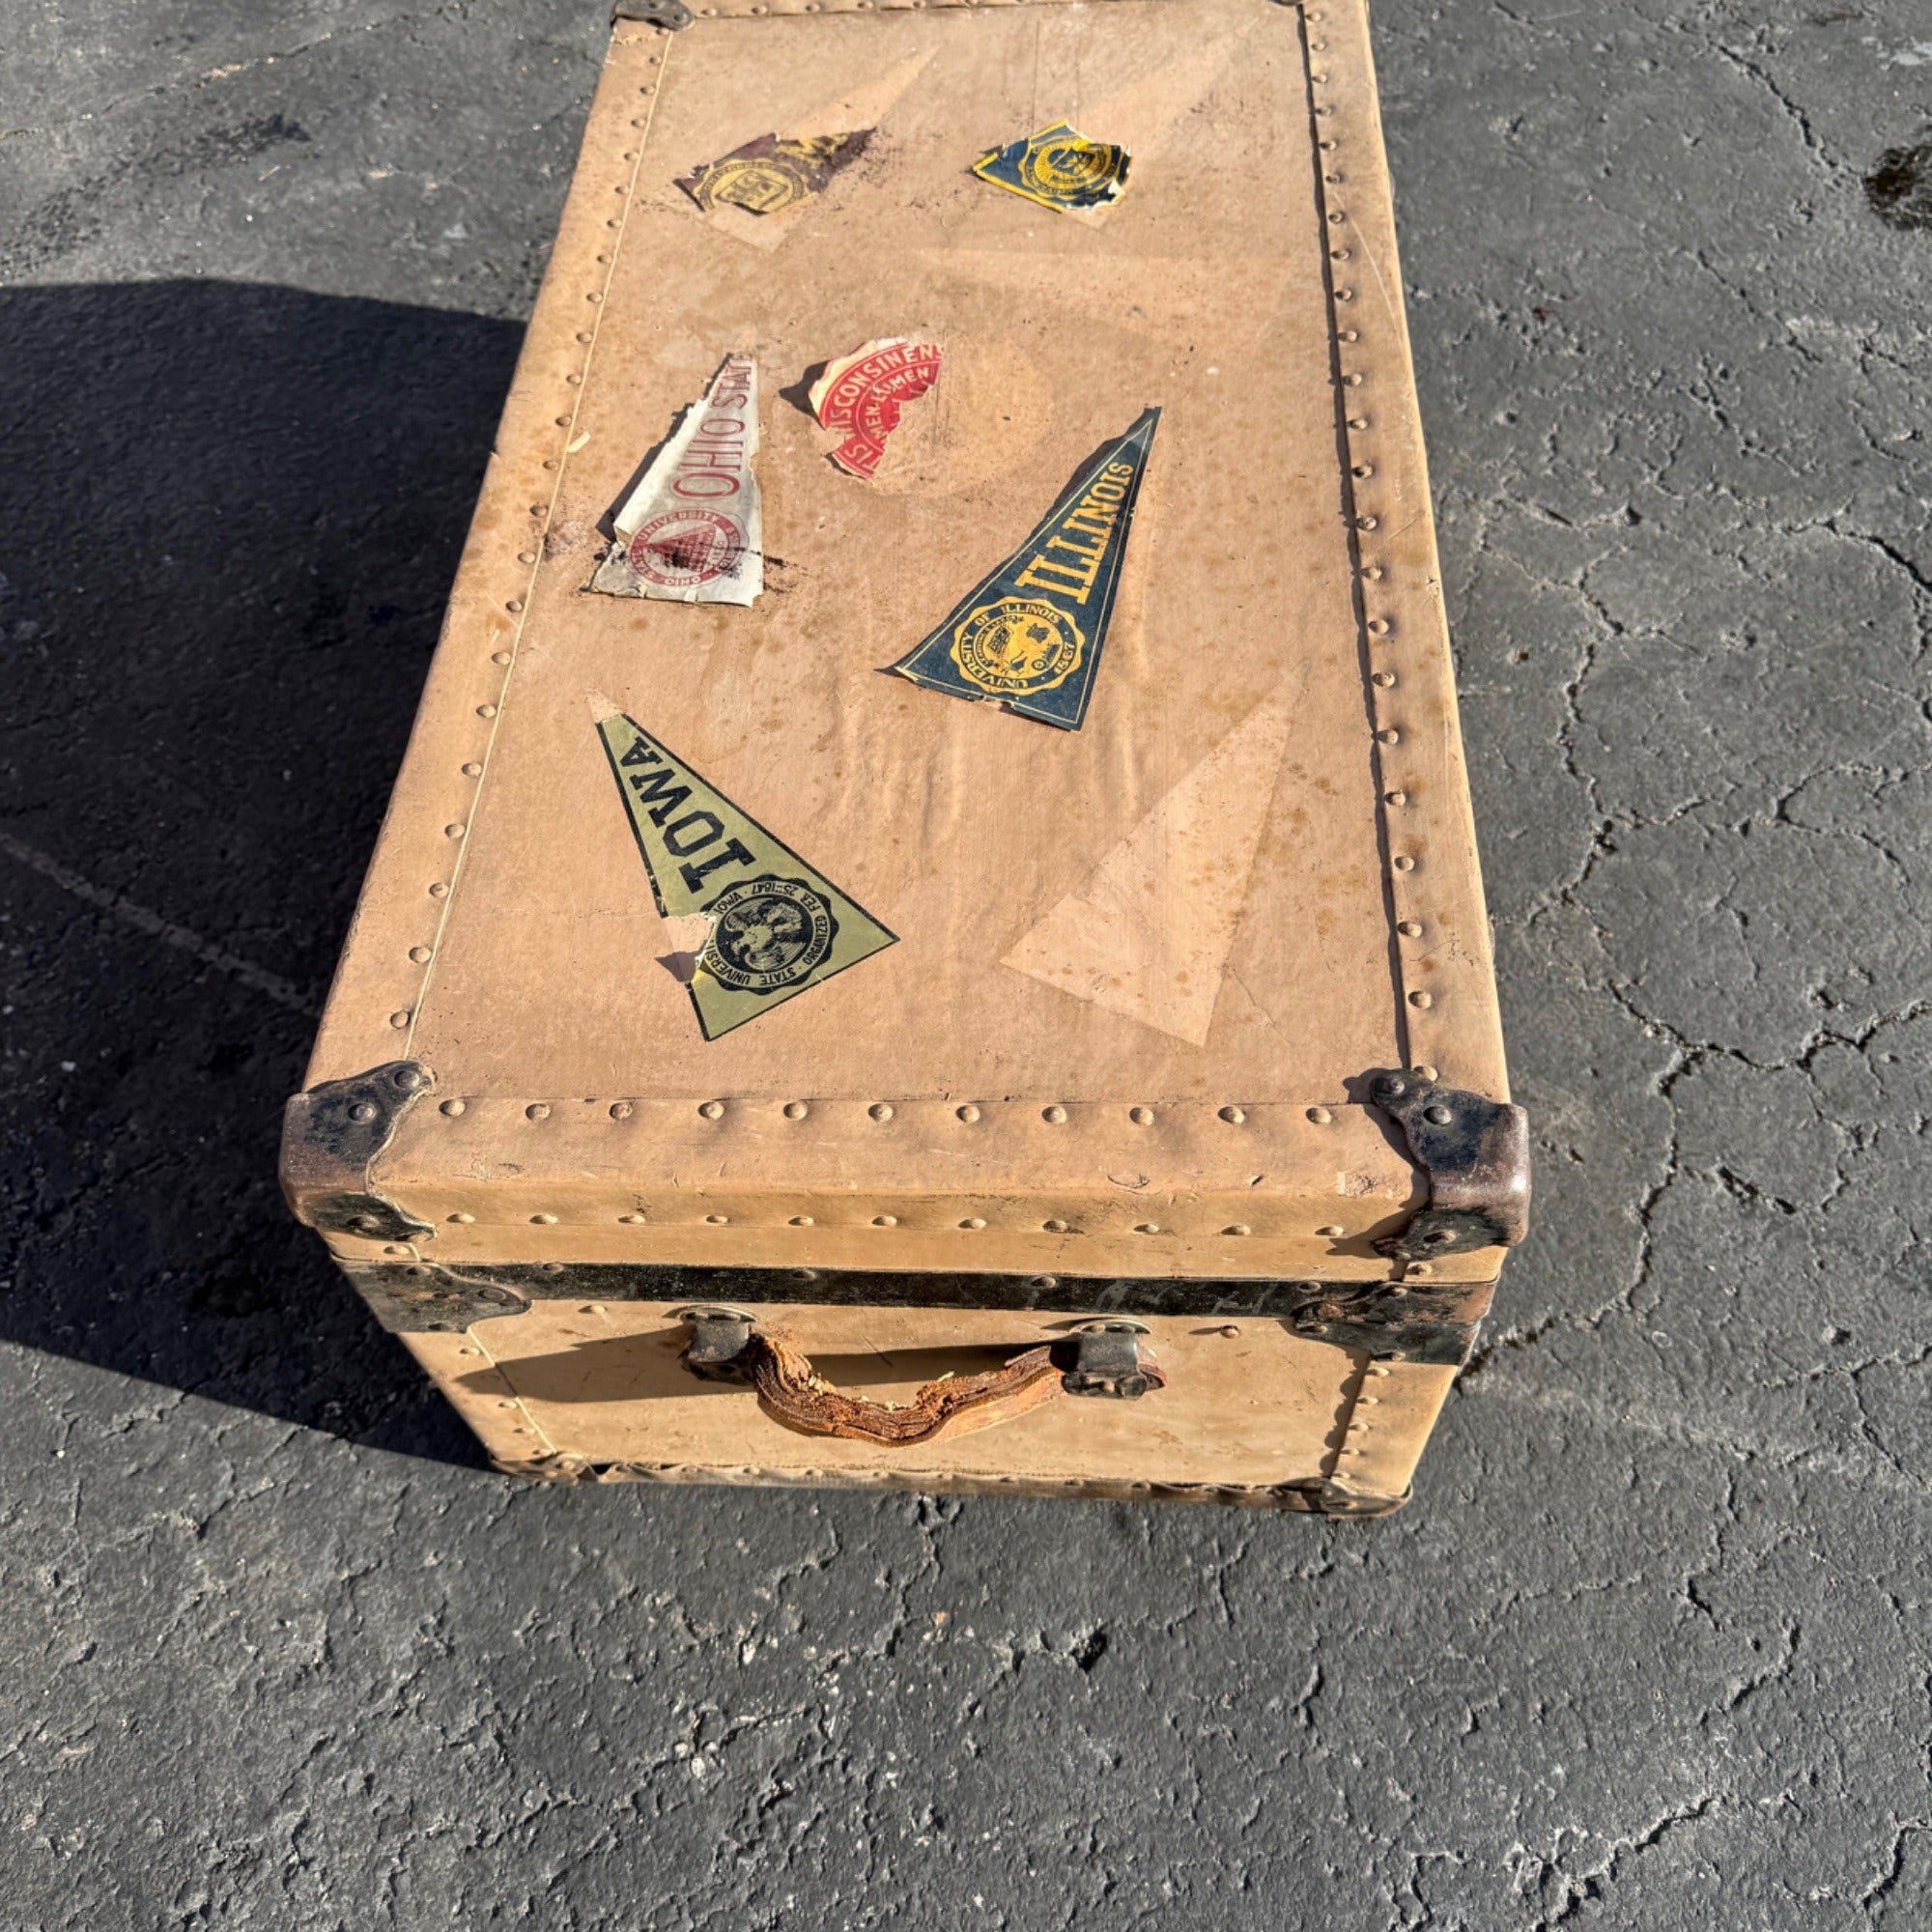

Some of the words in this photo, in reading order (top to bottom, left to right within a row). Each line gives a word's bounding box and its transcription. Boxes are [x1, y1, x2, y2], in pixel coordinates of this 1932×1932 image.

[672, 417, 746, 498] OHIO
[1014, 461, 1133, 605] ILLINOIS
[961, 632, 1028, 688] UNIVERSITY
[1001, 604, 1062, 624] ILLINOIS
[1053, 641, 1076, 674] 1867
[619, 736, 756, 895] IOWA
[714, 892, 743, 914] IOWA
[802, 915, 828, 965] ORGANIZED
[759, 967, 797, 985] STATE
